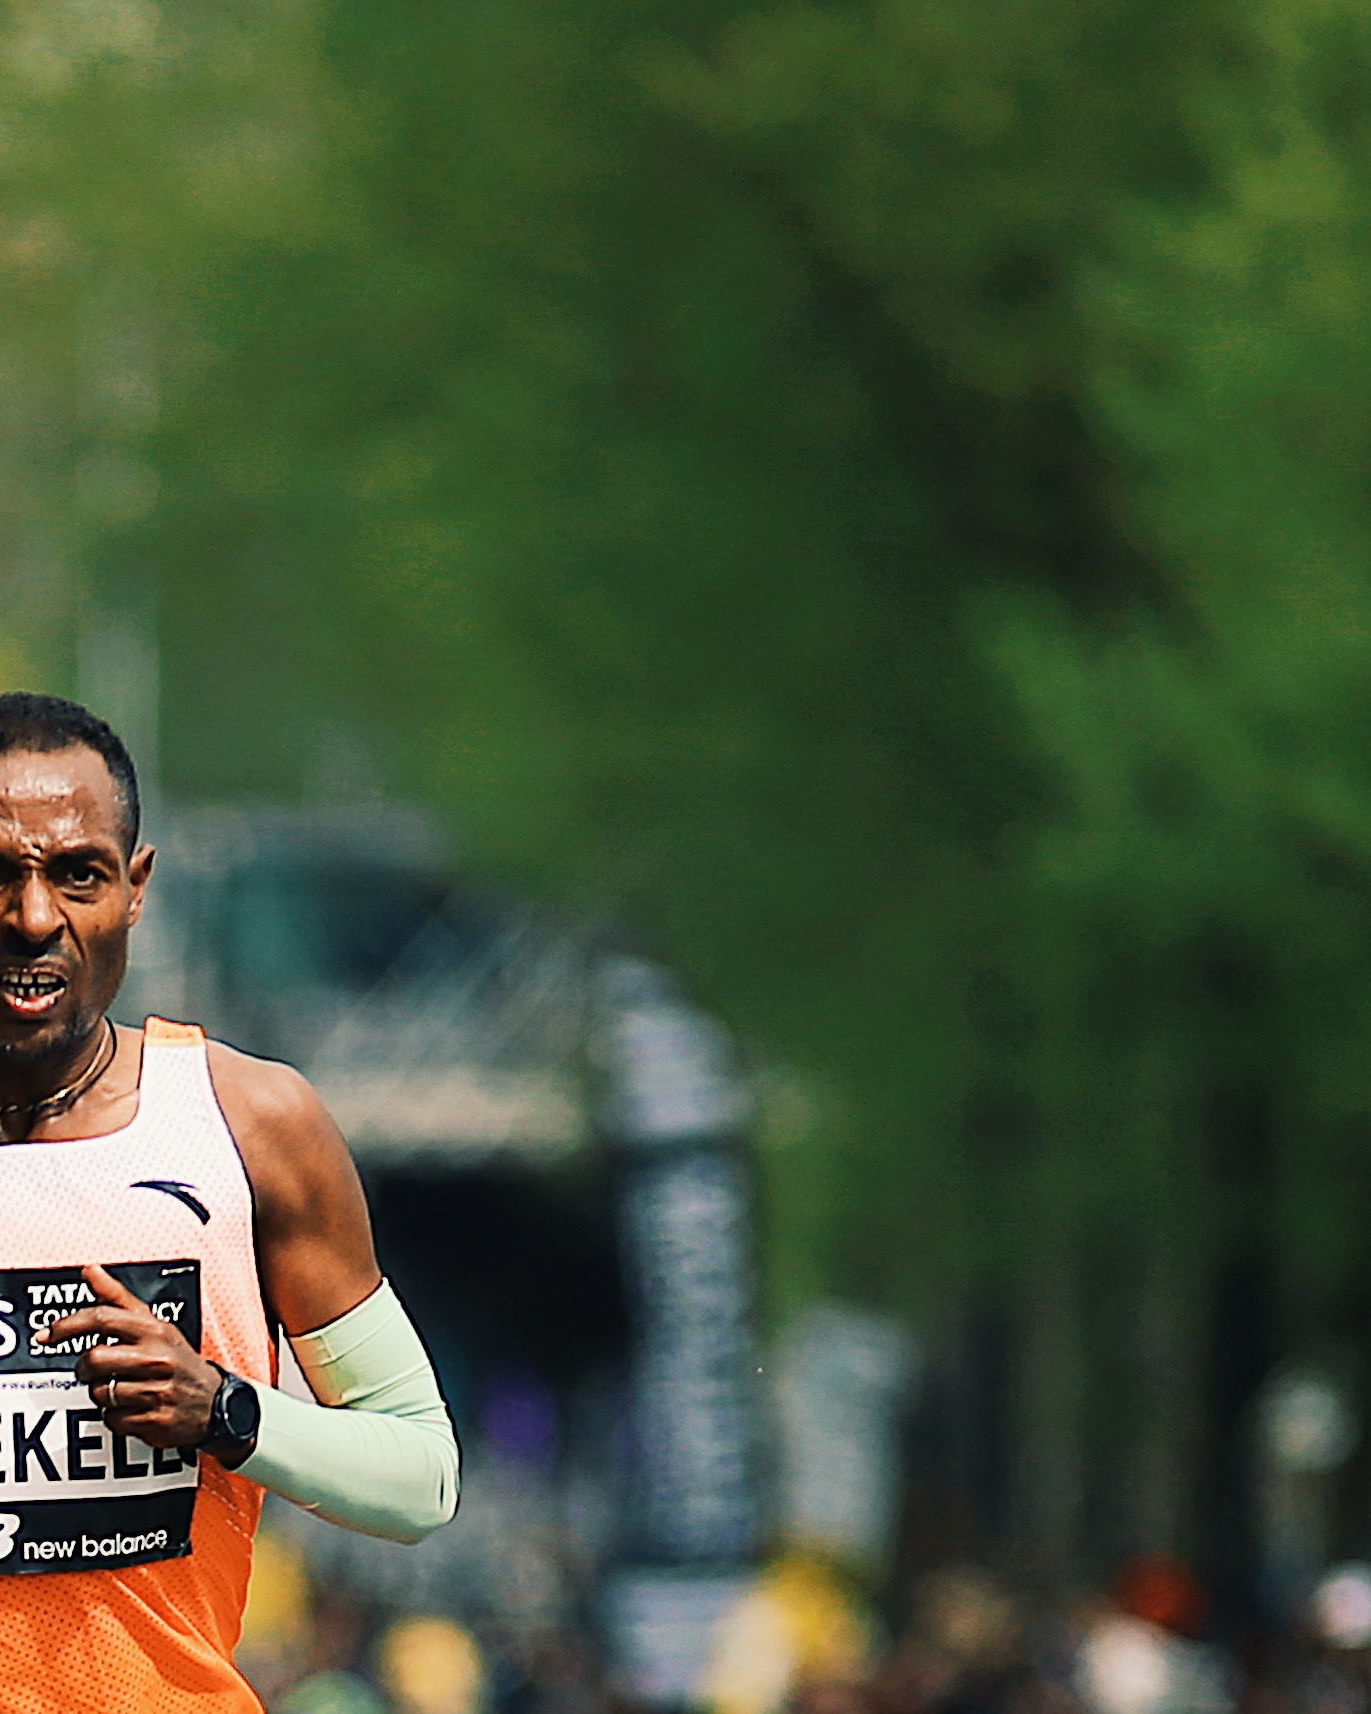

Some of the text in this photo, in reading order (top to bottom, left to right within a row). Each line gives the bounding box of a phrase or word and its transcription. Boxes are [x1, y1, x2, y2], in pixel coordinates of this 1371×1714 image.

[27, 1282, 97, 1305] TATA
[23, 1529, 168, 1560] new balance
